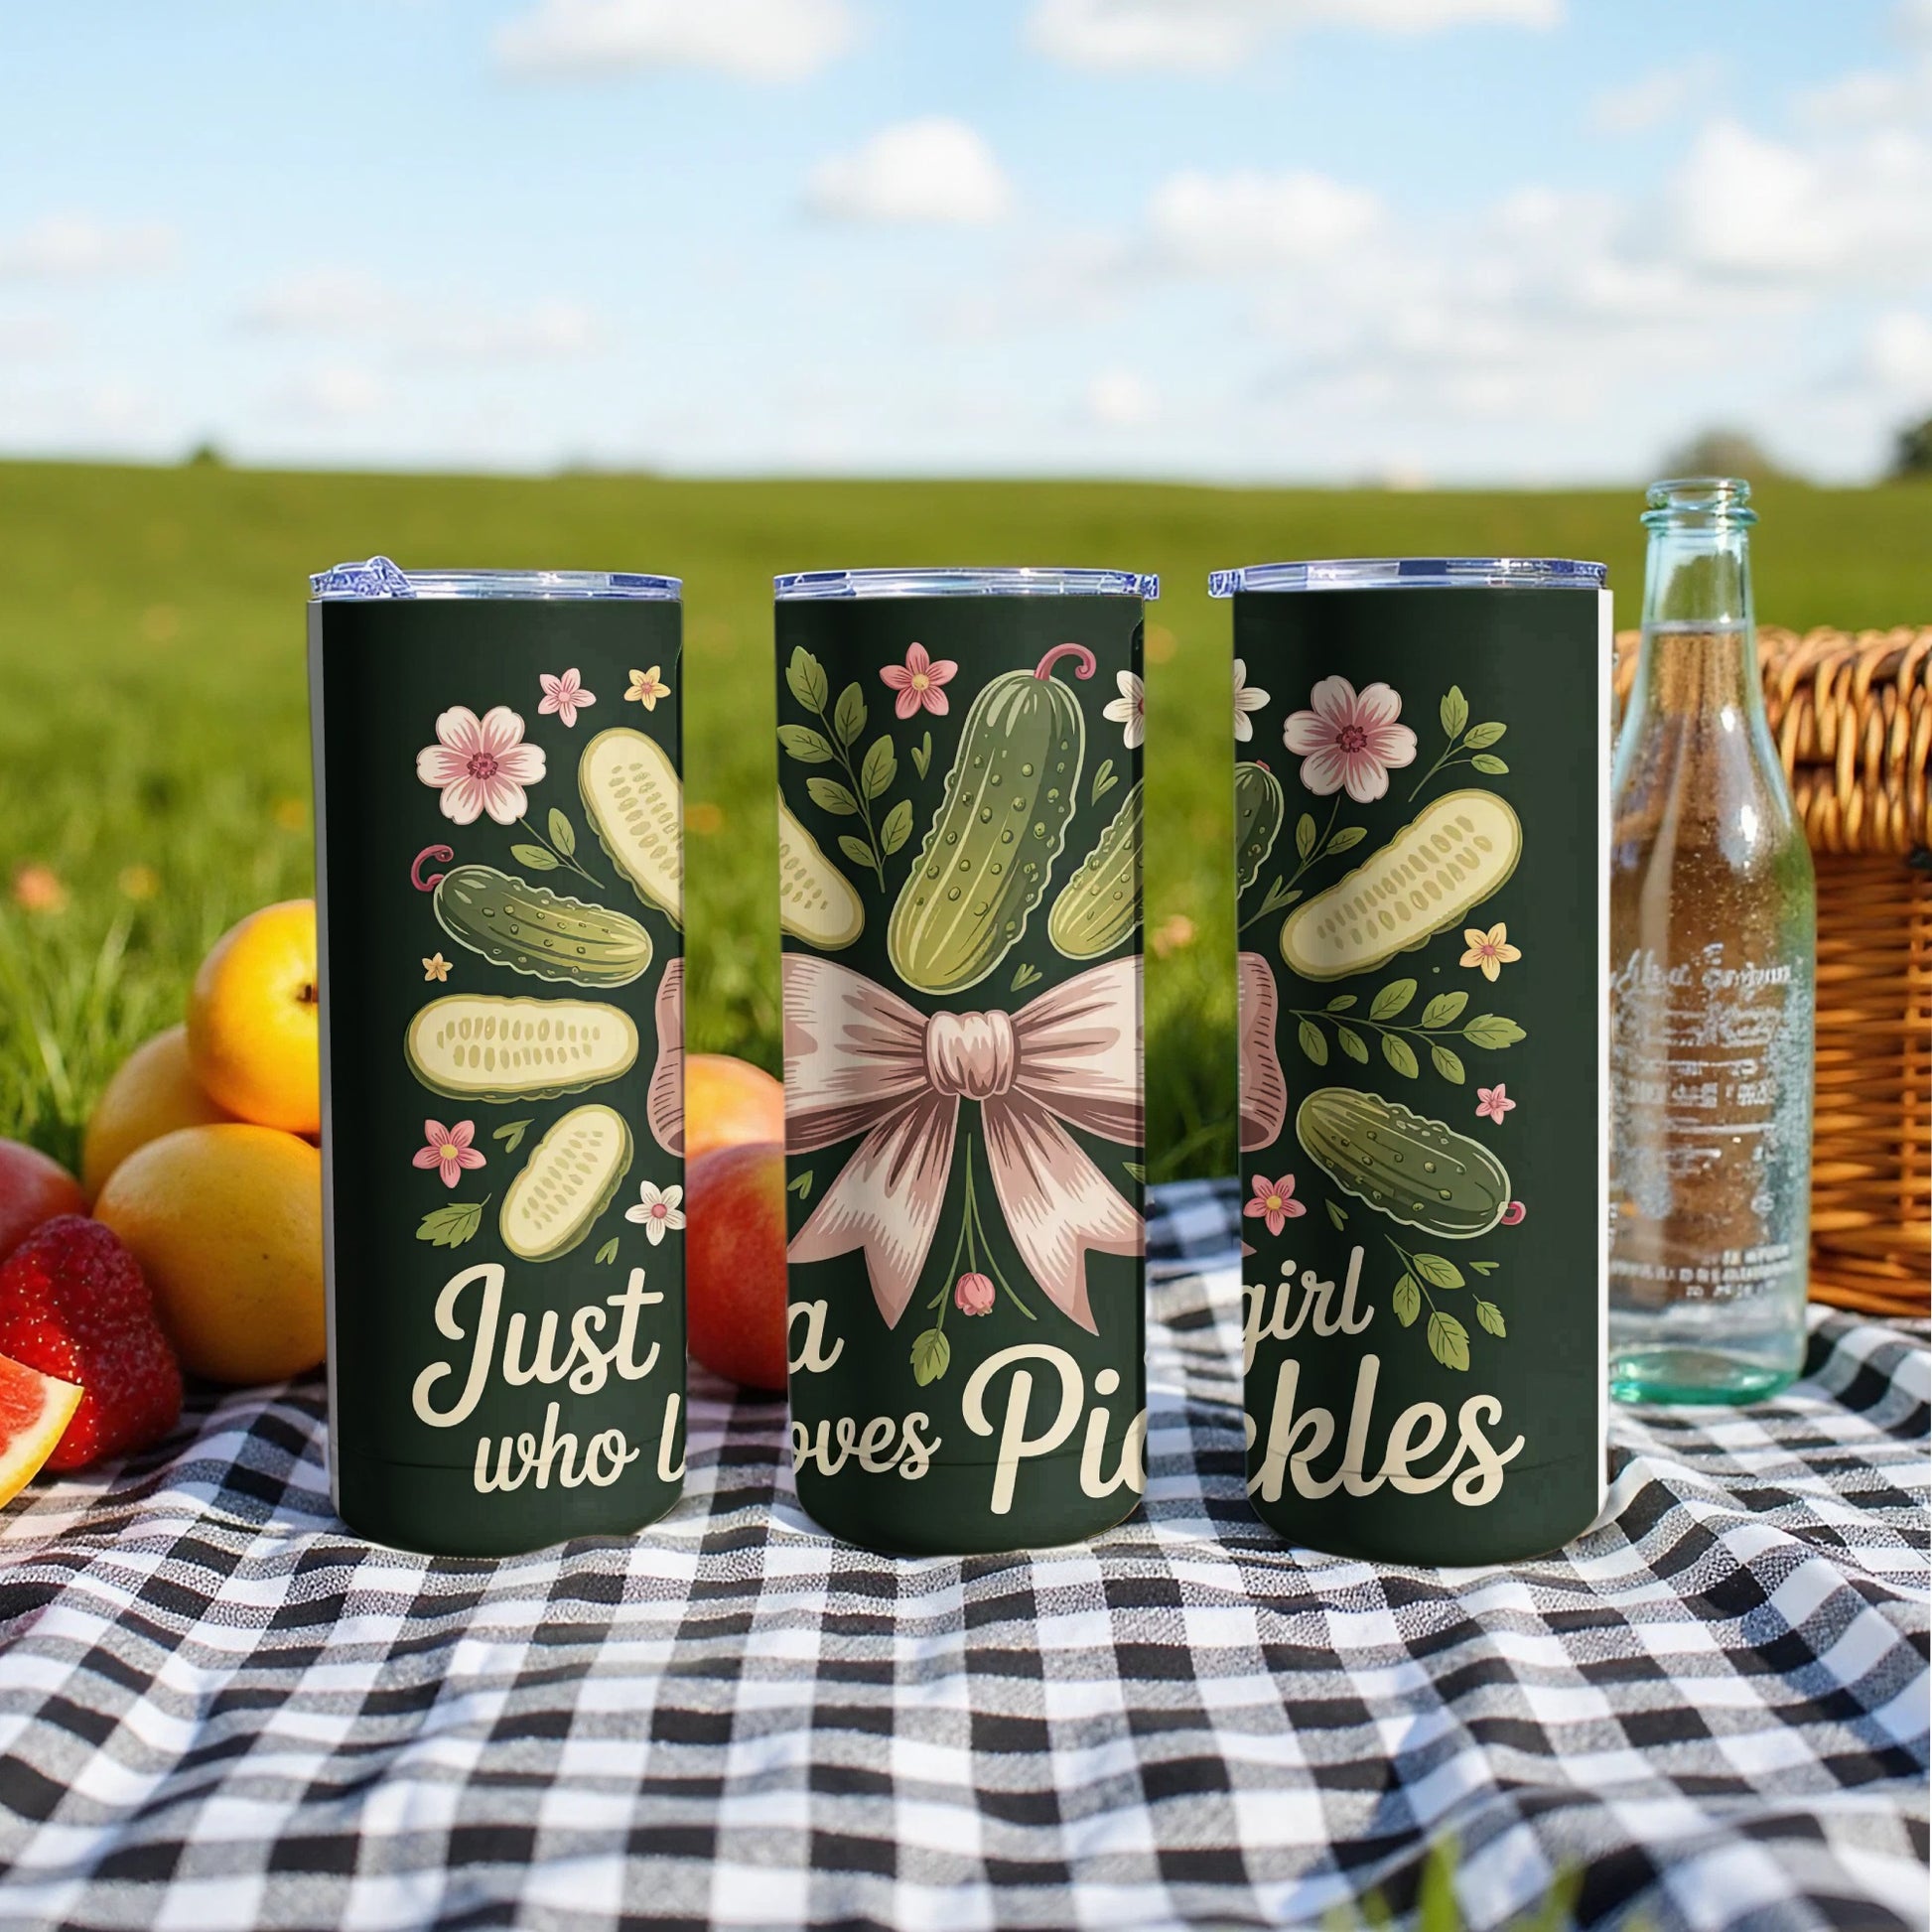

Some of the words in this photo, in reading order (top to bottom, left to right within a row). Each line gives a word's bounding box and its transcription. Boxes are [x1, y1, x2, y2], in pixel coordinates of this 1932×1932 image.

[412, 1263, 664, 1428] Just
[1242, 1245, 1375, 1377] girl
[474, 1401, 640, 1493] who
